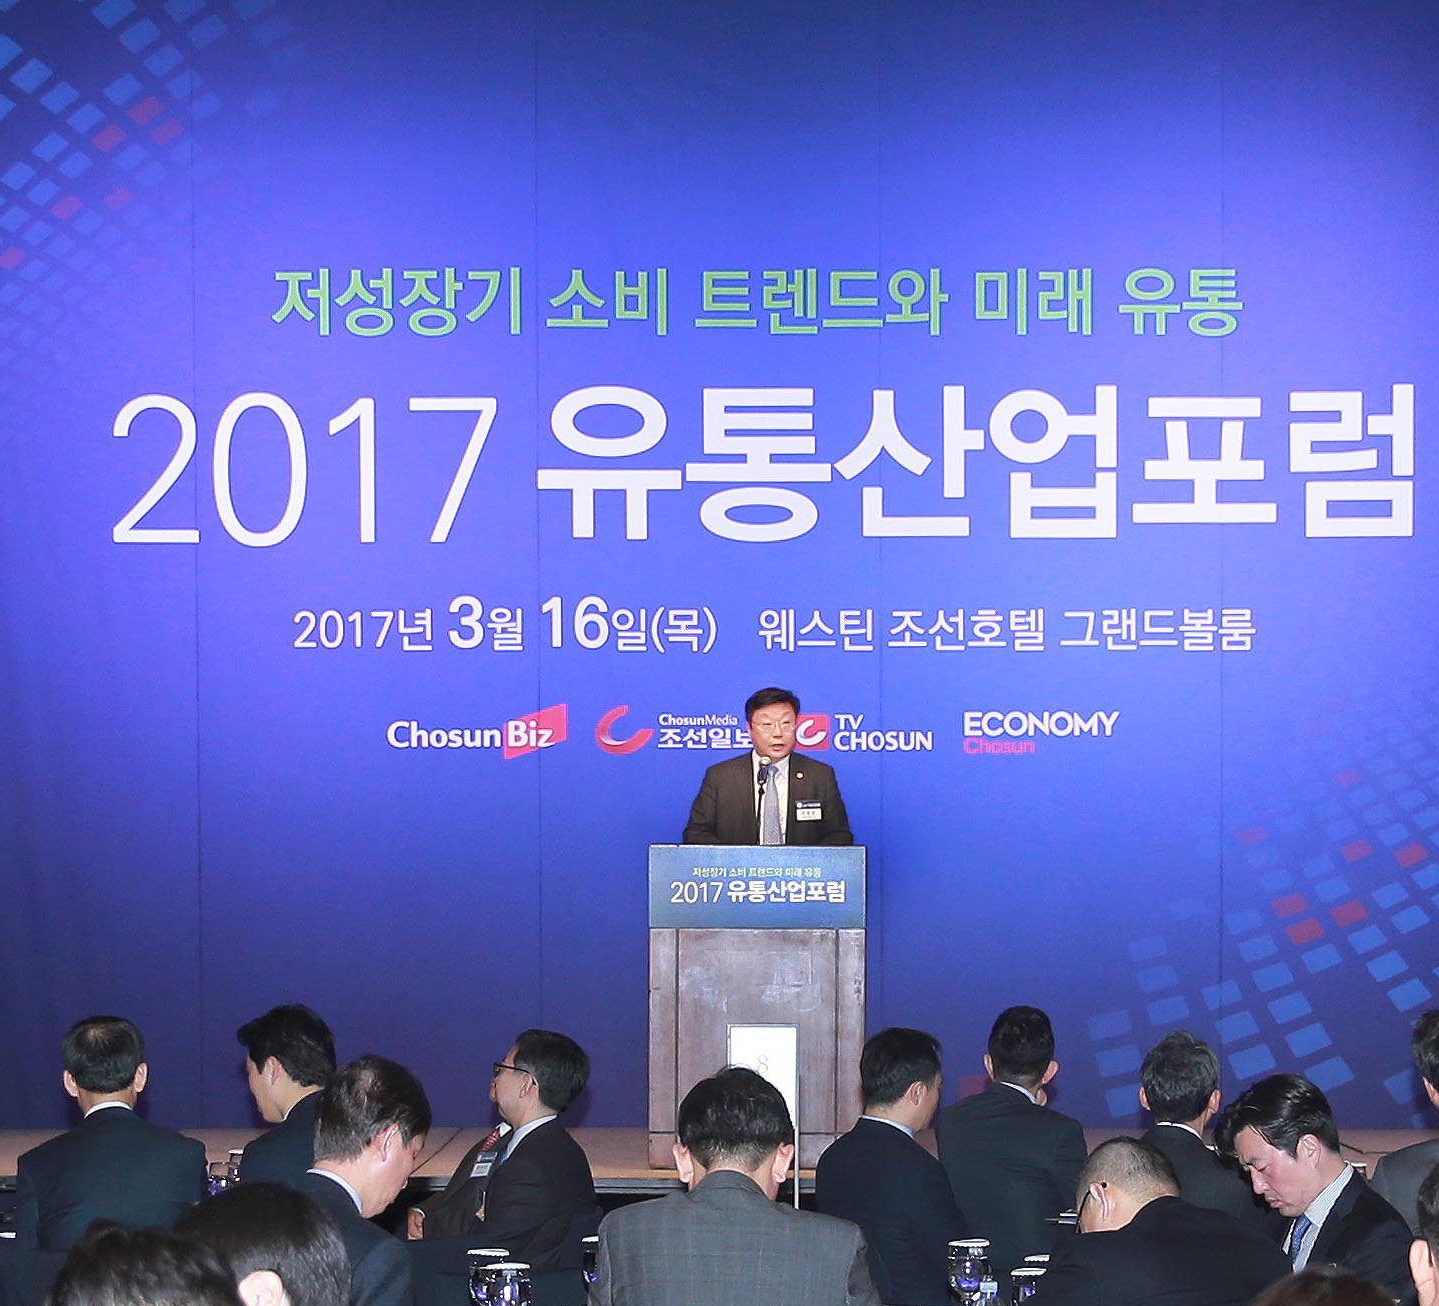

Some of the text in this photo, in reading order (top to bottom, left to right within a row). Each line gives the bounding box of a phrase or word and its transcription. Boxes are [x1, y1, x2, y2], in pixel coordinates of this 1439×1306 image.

[272, 267, 1244, 337] 저성장기 소비 트렌드와 미래 유통
[112, 383, 1415, 547] 2017 유통산업포럼
[293, 595, 1258, 654] 2017년 3월 16일(목) 웨스틴 조선호텔 그랜드볼룸
[657, 713, 739, 727] ChosunMedia
[833, 713, 865, 731] TV
[963, 710, 1121, 738] ECONOMY
[386, 719, 554, 749] Chosun Biz
[833, 731, 934, 752] CHOSUN
[964, 737, 1036, 755] Chosun
[670, 879, 847, 904] 2017 유통산업포럼
[757, 1054, 768, 1074] 8
